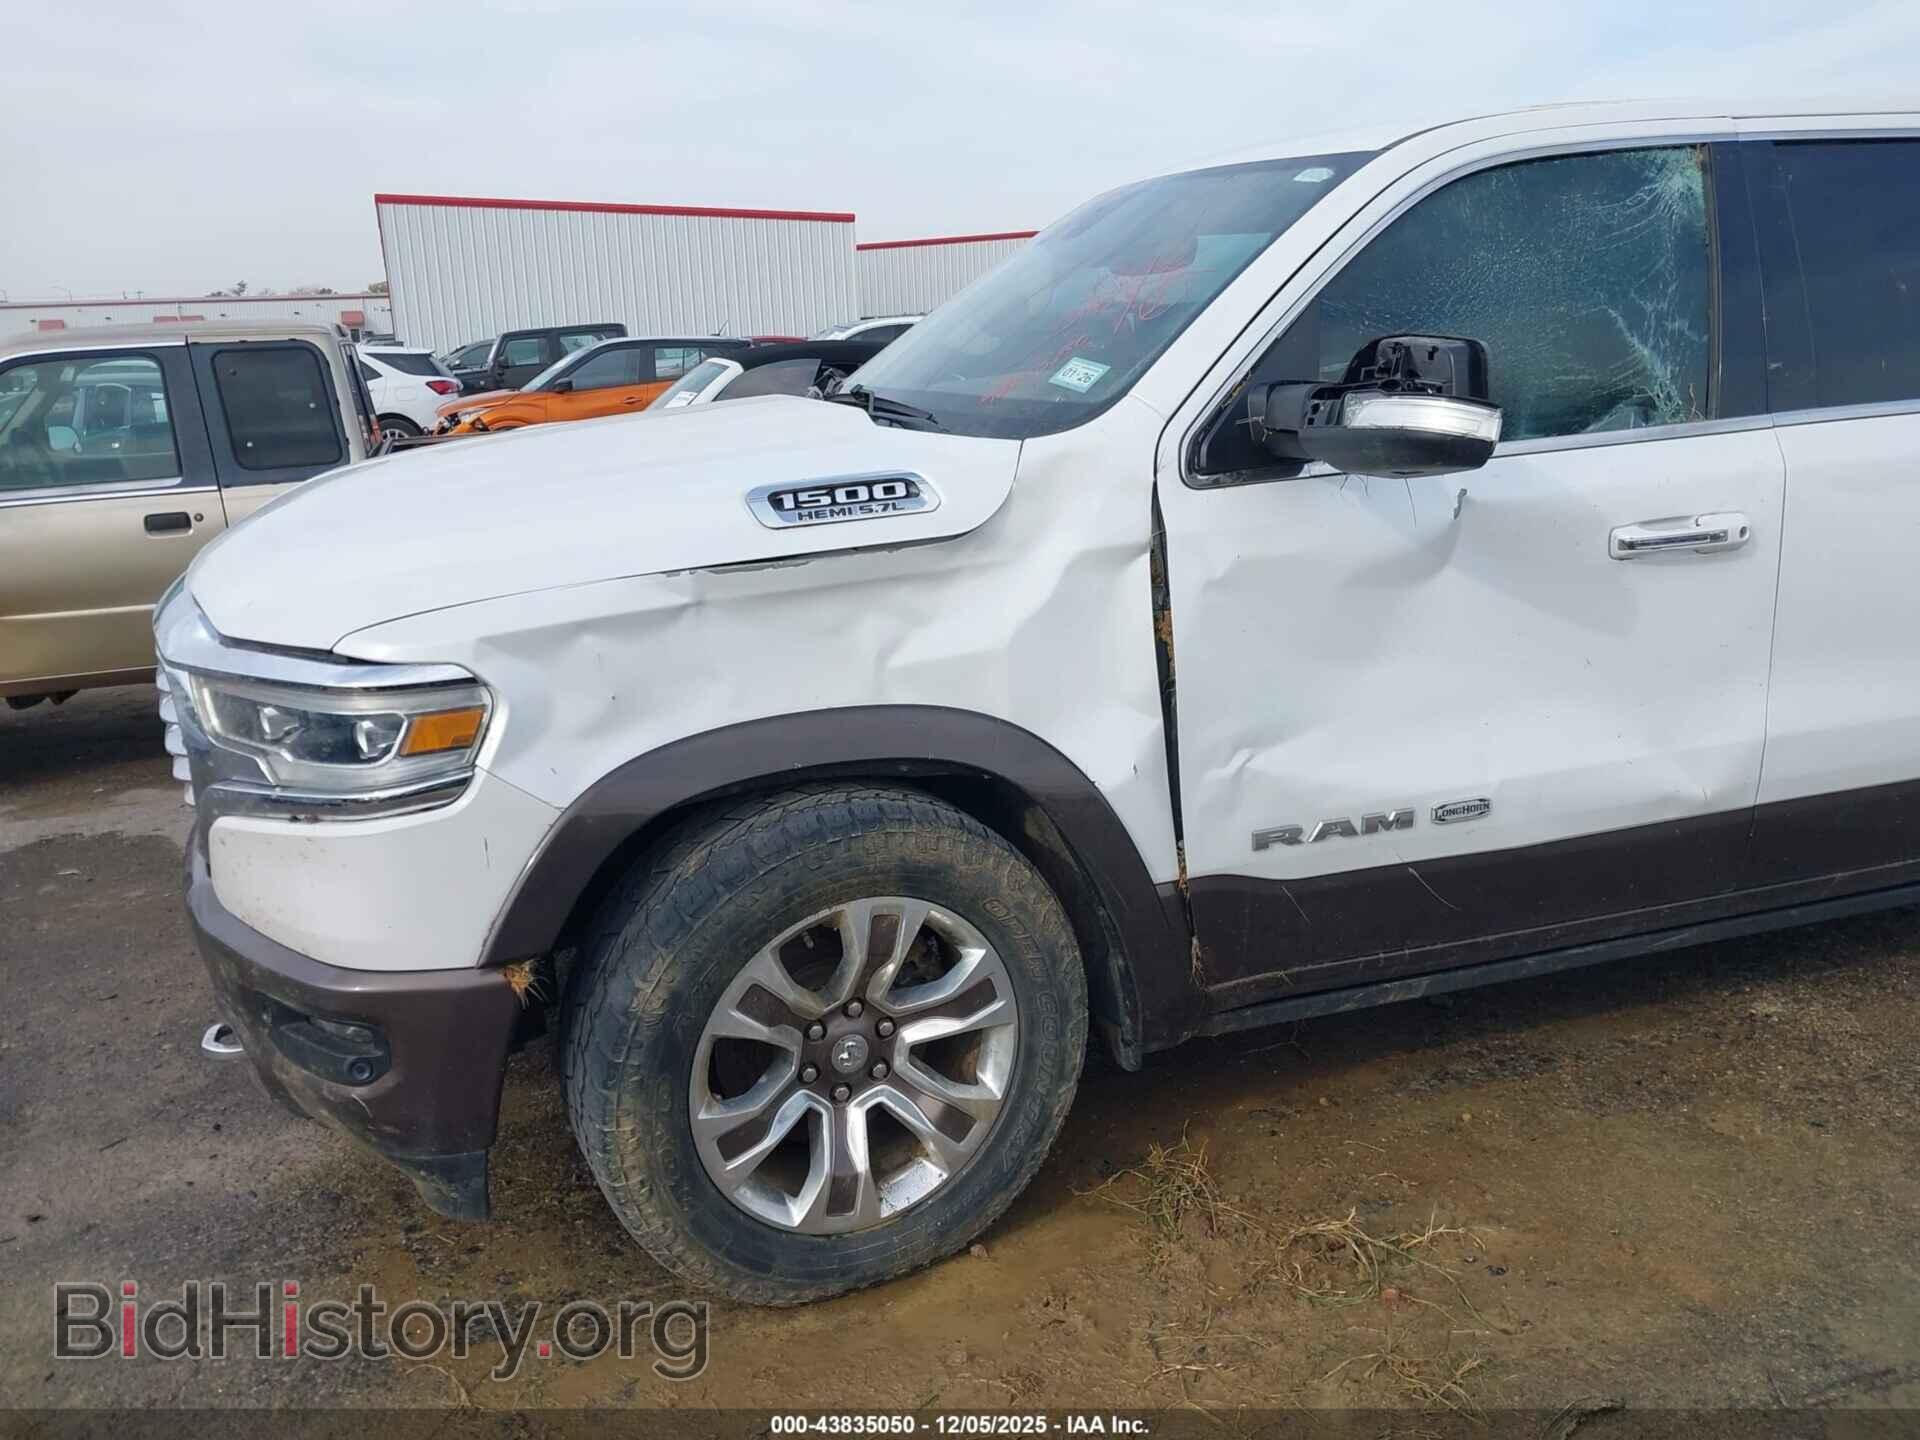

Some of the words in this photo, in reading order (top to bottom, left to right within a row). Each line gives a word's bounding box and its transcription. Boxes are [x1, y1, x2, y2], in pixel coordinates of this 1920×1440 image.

[776, 481, 908, 511] 1500
[798, 506, 853, 521] HEMI
[859, 501, 906, 515] 5.7L
[1252, 807, 1416, 851] RAM
